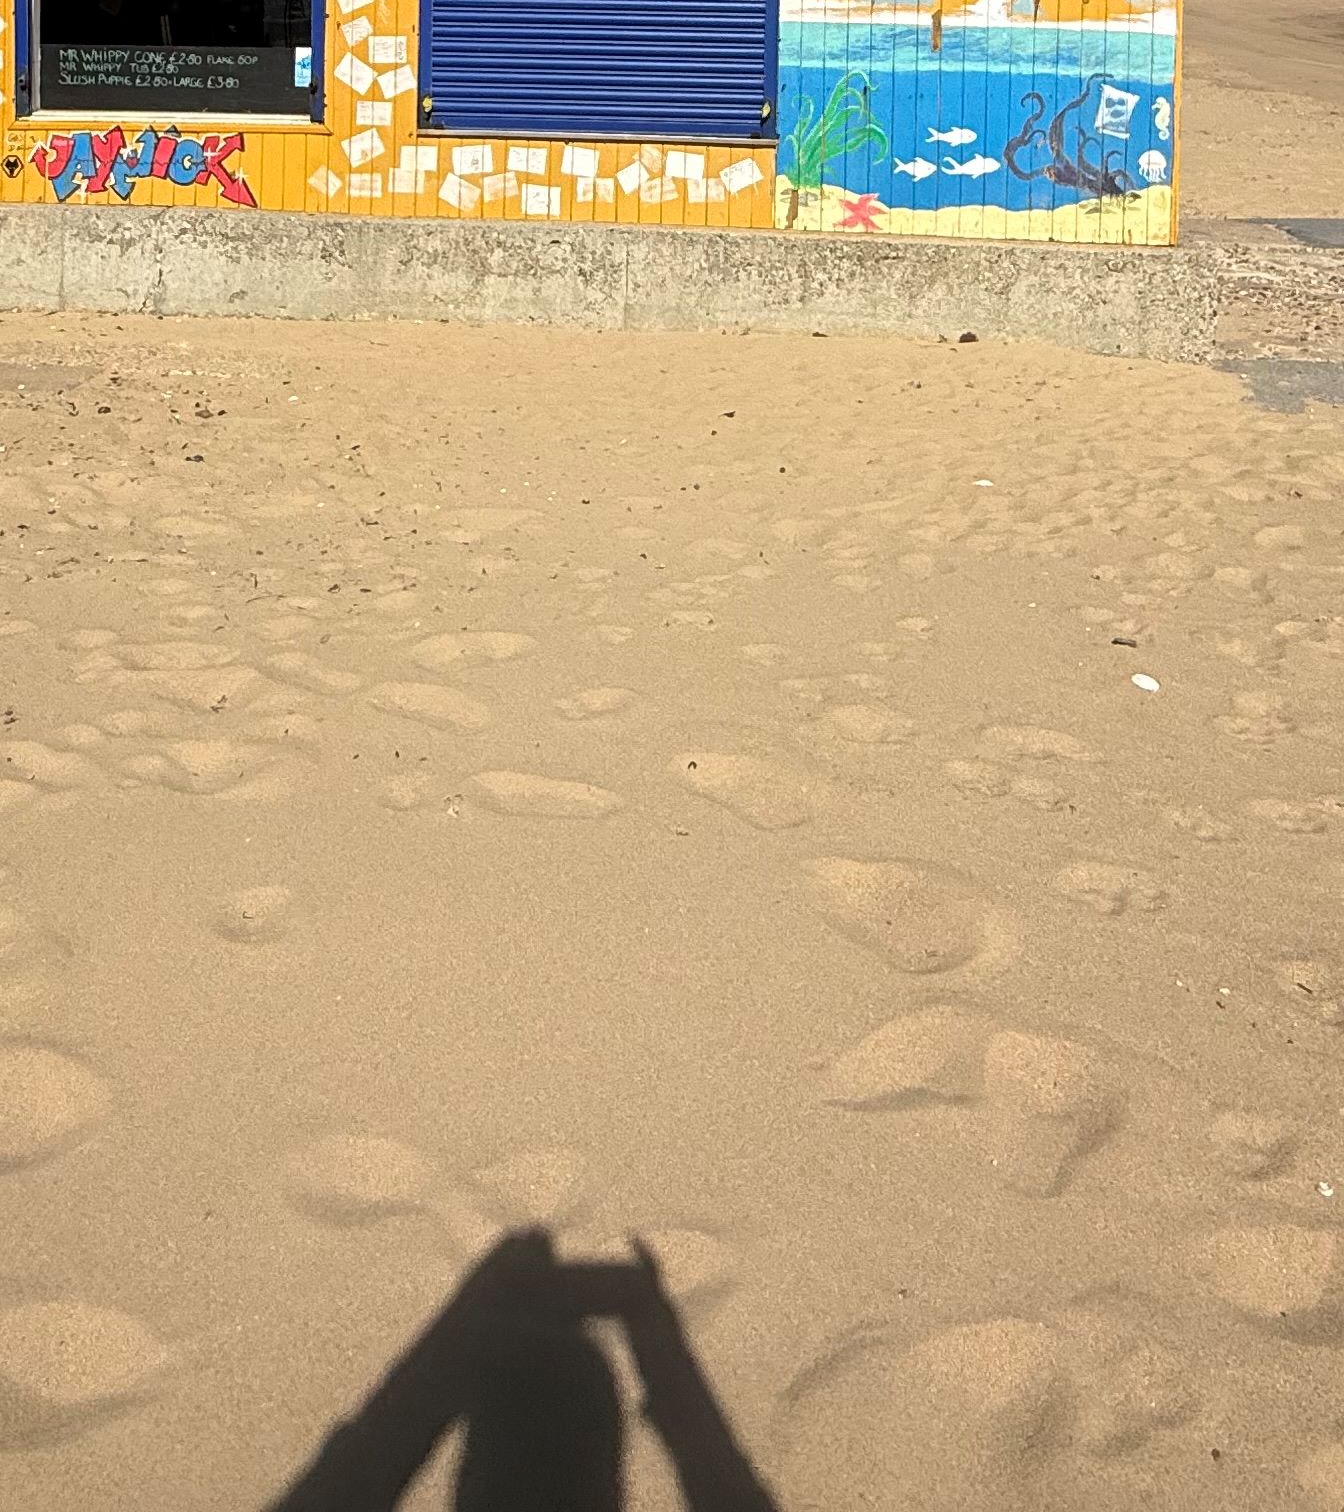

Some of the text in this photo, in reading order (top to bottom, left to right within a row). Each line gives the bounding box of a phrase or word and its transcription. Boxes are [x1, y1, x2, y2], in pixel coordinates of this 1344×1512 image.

[59, 49, 79, 63] MR
[206, 54, 235, 65] FLAKE
[59, 61, 76, 72] MR
[129, 63, 149, 74] TUB
[58, 71, 96, 86] SLUSH
[173, 76, 205, 88] LARGE
